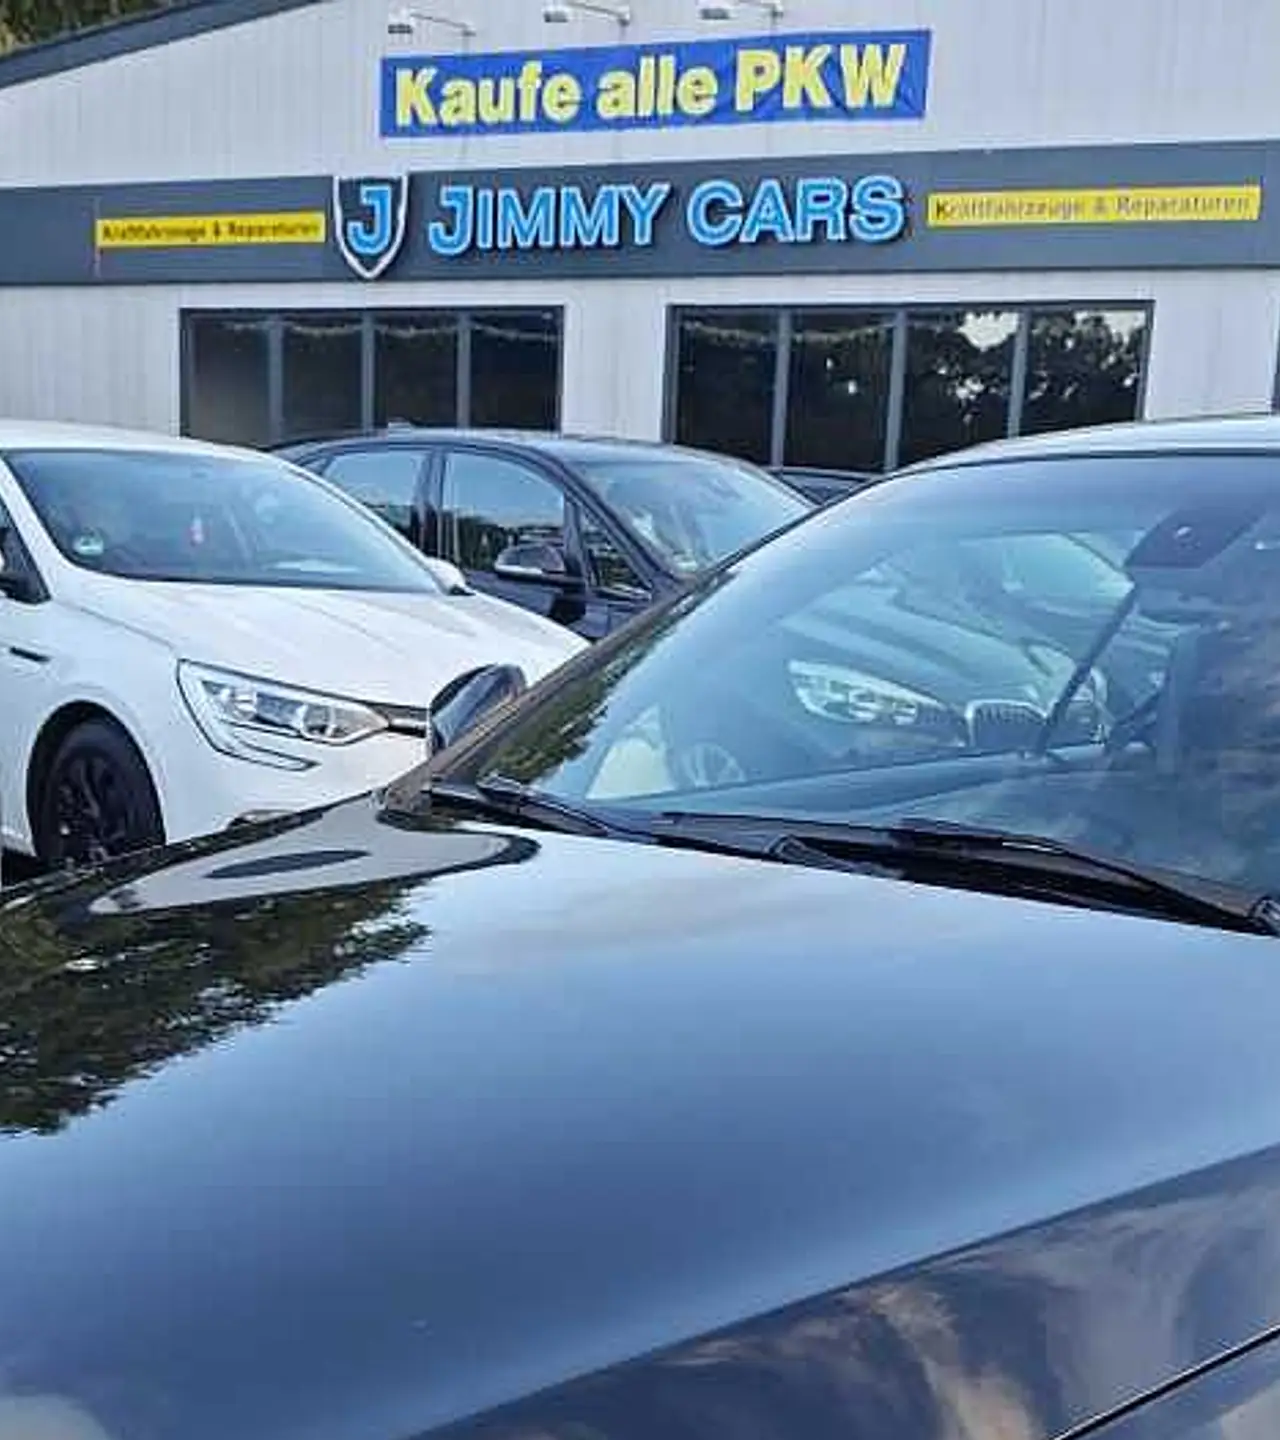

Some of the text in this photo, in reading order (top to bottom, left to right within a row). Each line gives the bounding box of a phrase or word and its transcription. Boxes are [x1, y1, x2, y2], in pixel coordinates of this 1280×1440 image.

[394, 43, 908, 128] Kaufe alle PKW
[346, 183, 394, 255] J
[426, 174, 906, 257] JIMMY CARS
